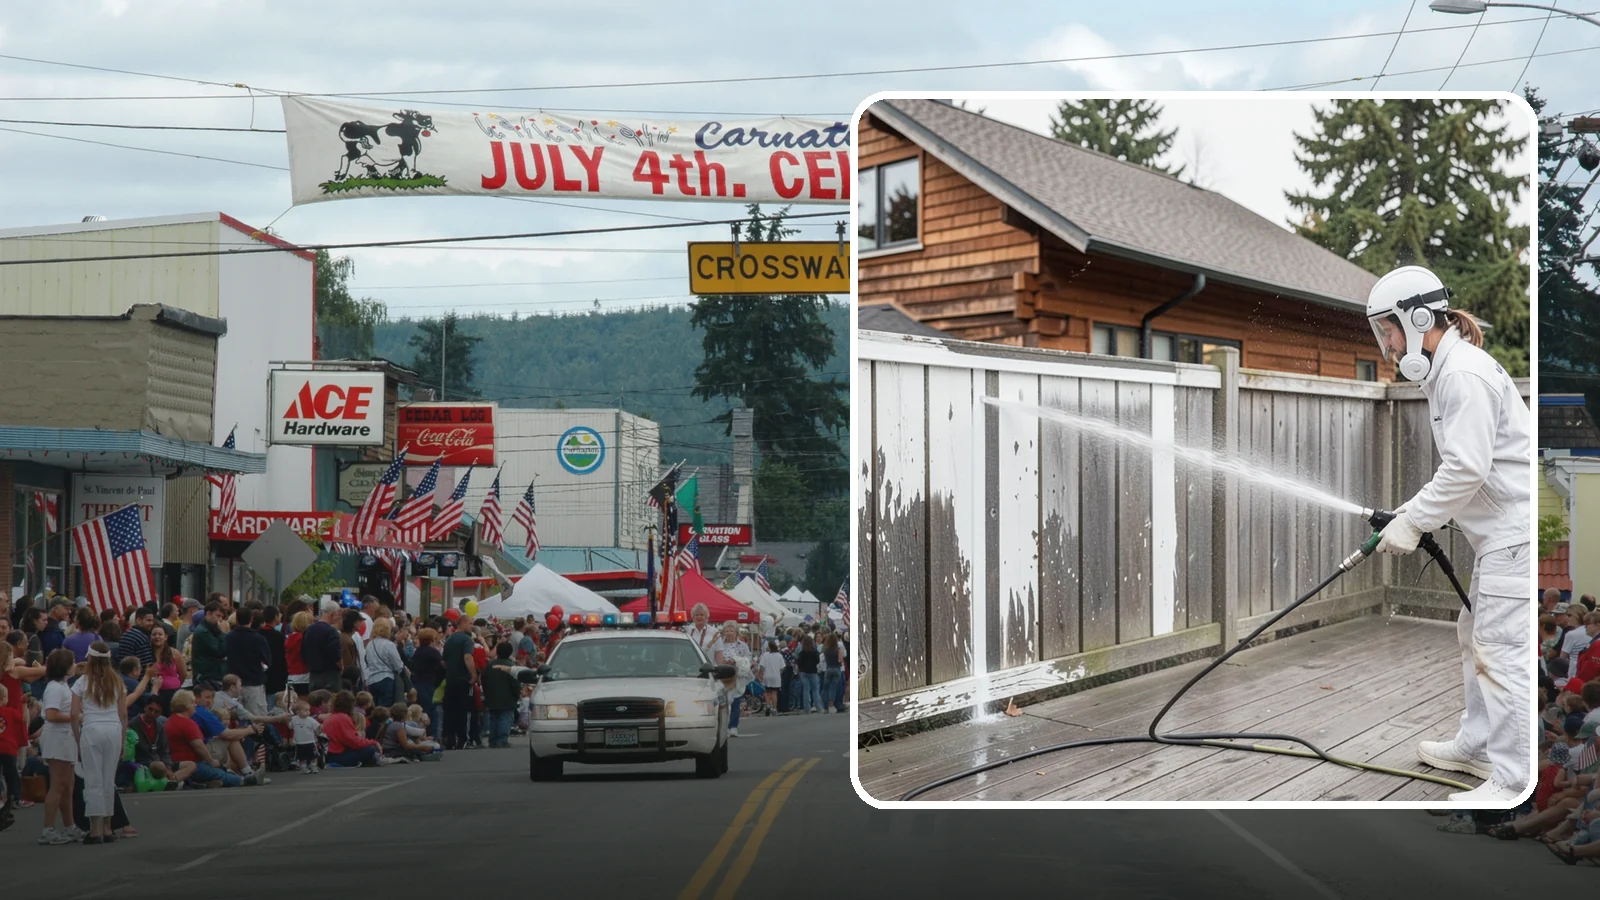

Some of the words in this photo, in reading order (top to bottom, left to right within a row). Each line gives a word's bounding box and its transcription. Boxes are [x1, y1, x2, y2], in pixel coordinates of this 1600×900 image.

[481, 141, 605, 193] JULY
[632, 149, 747, 198] 4th.
[696, 254, 850, 280] CROSSWA
[283, 380, 373, 420] ACE
[405, 409, 452, 422] CEDAR
[461, 409, 485, 422] LOG
[283, 421, 371, 436] Hardware
[353, 467, 384, 479] Simpl
[83, 485, 93, 494] St.
[96, 485, 124, 495] Vincent
[126, 486, 136, 495] de
[137, 486, 155, 495] Paul
[688, 526, 742, 535] CRNATION
[699, 535, 730, 543] GLASS
